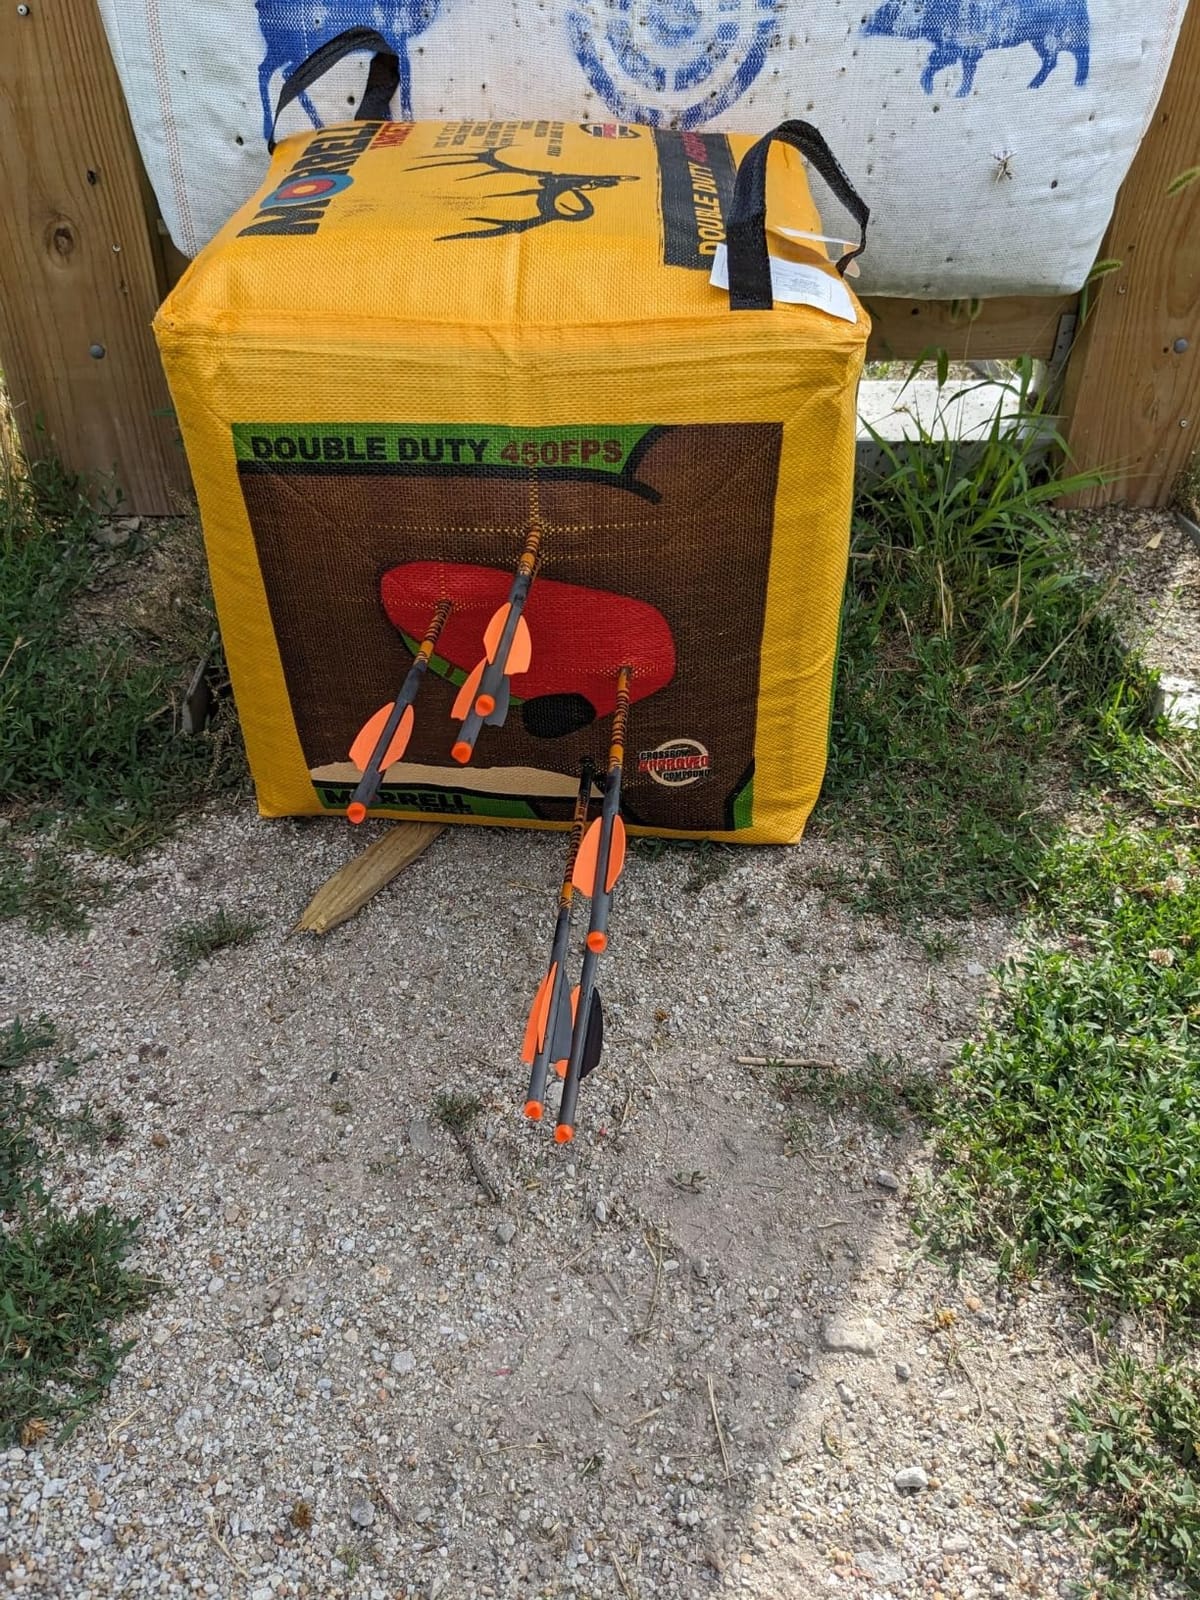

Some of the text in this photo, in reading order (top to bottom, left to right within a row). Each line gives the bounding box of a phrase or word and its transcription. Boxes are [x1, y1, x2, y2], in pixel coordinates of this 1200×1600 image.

[236, 123, 384, 238] MORRELL
[687, 161, 718, 194] DUTY
[693, 193, 727, 255] DOUBLE
[251, 437, 623, 466] DOUBLE DUTY 450FPS
[323, 788, 471, 808] MRRELL
